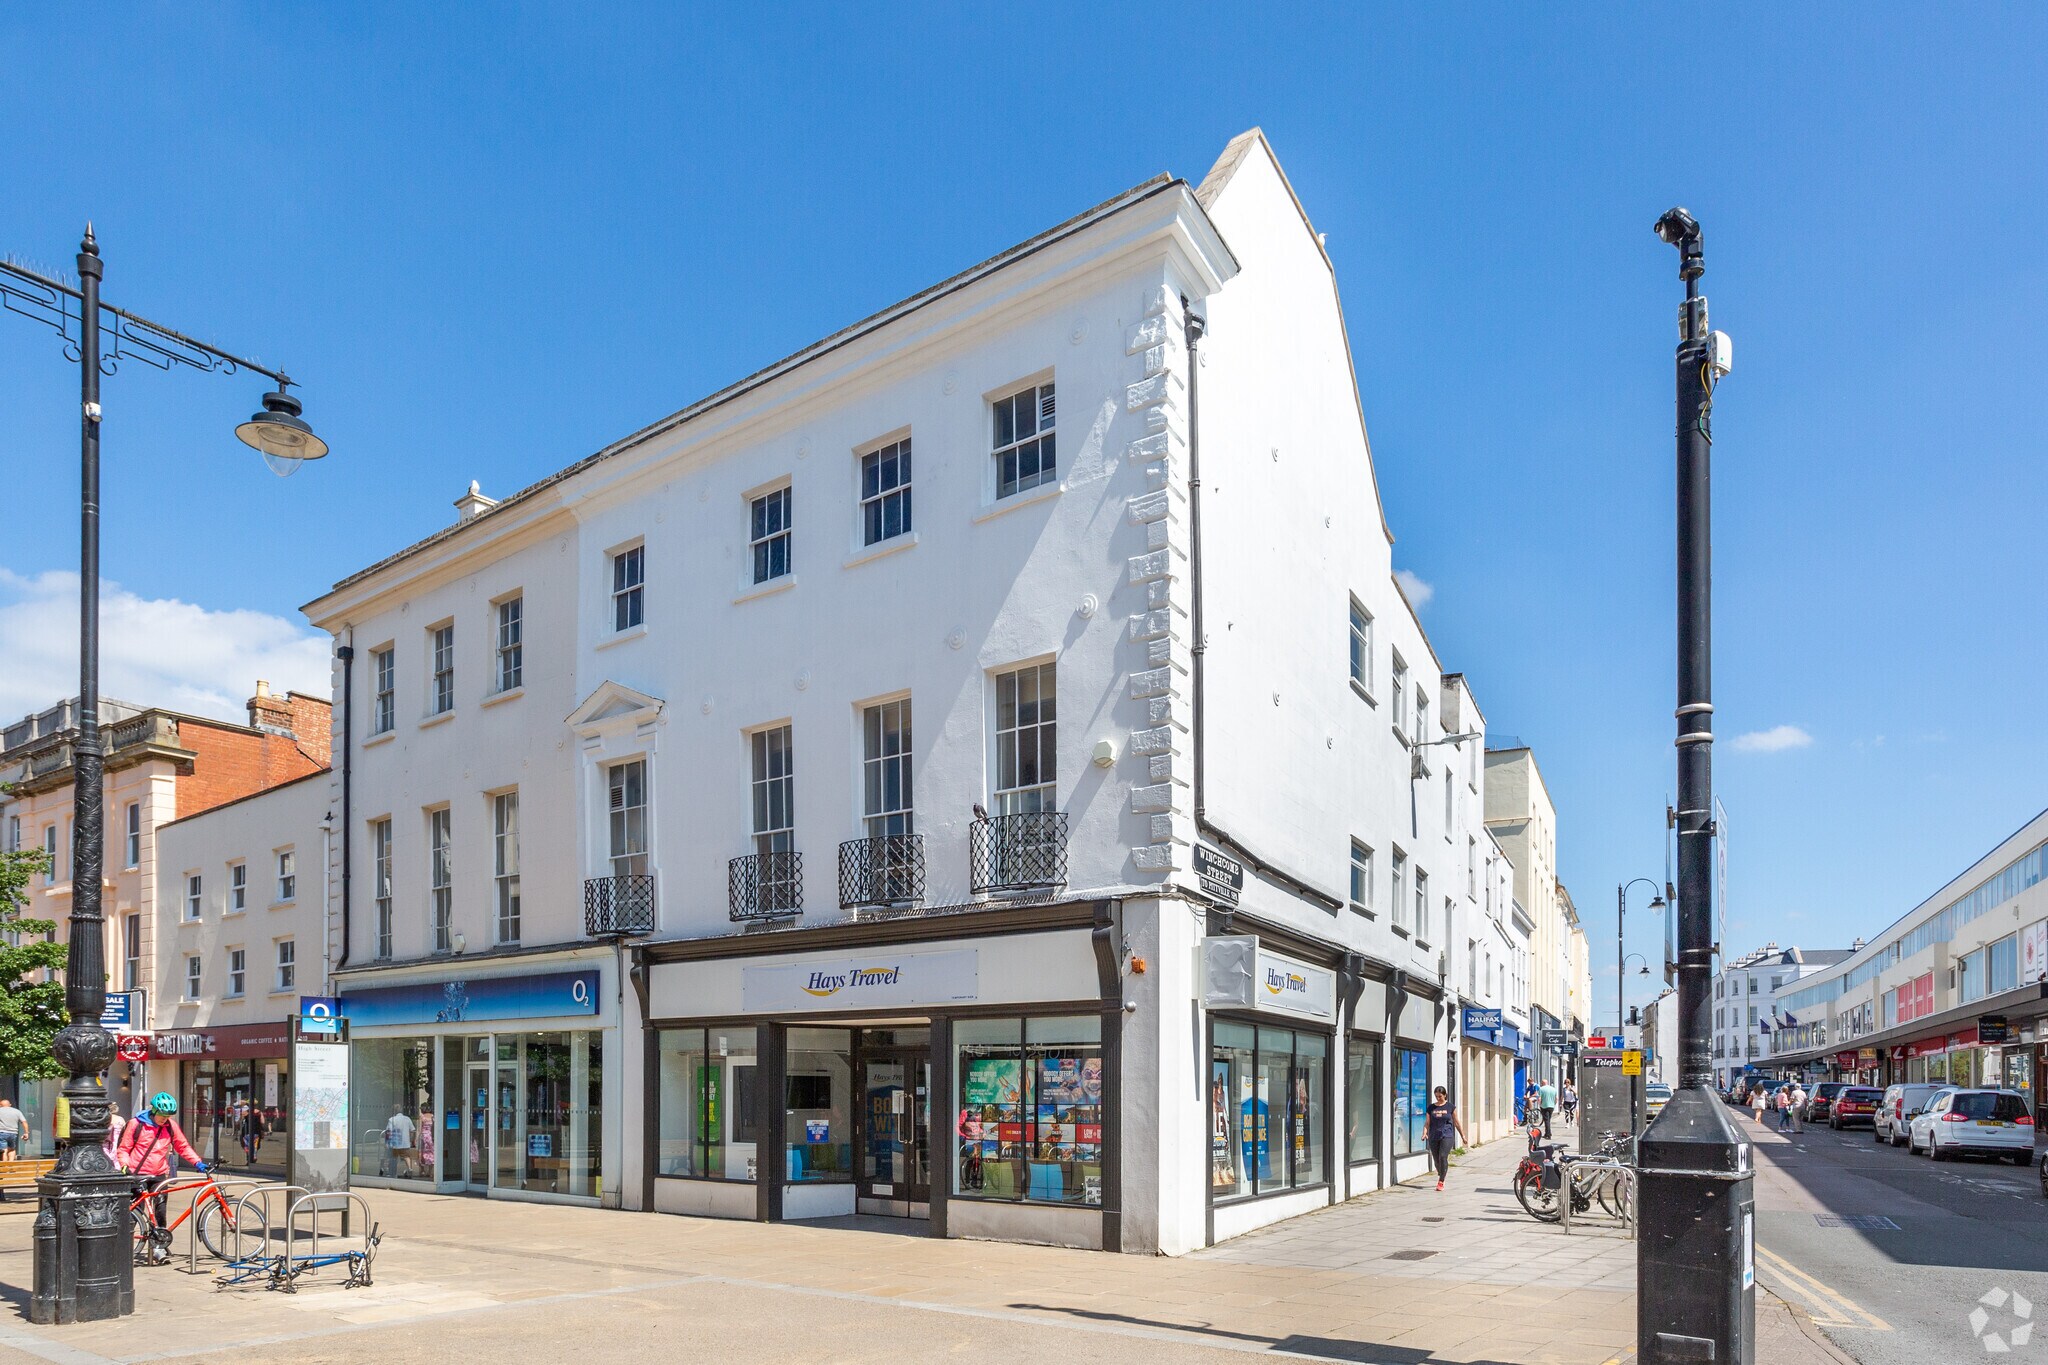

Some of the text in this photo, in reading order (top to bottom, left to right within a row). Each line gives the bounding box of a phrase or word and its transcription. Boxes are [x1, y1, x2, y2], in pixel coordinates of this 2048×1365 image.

[1206, 865, 1232, 886] STREET
[807, 966, 900, 993] Hays Travel
[1267, 967, 1306, 993] Hays Travel
[572, 979, 590, 1007] O2
[309, 1002, 335, 1027] O2
[1595, 1058, 1623, 1067] Telepho
